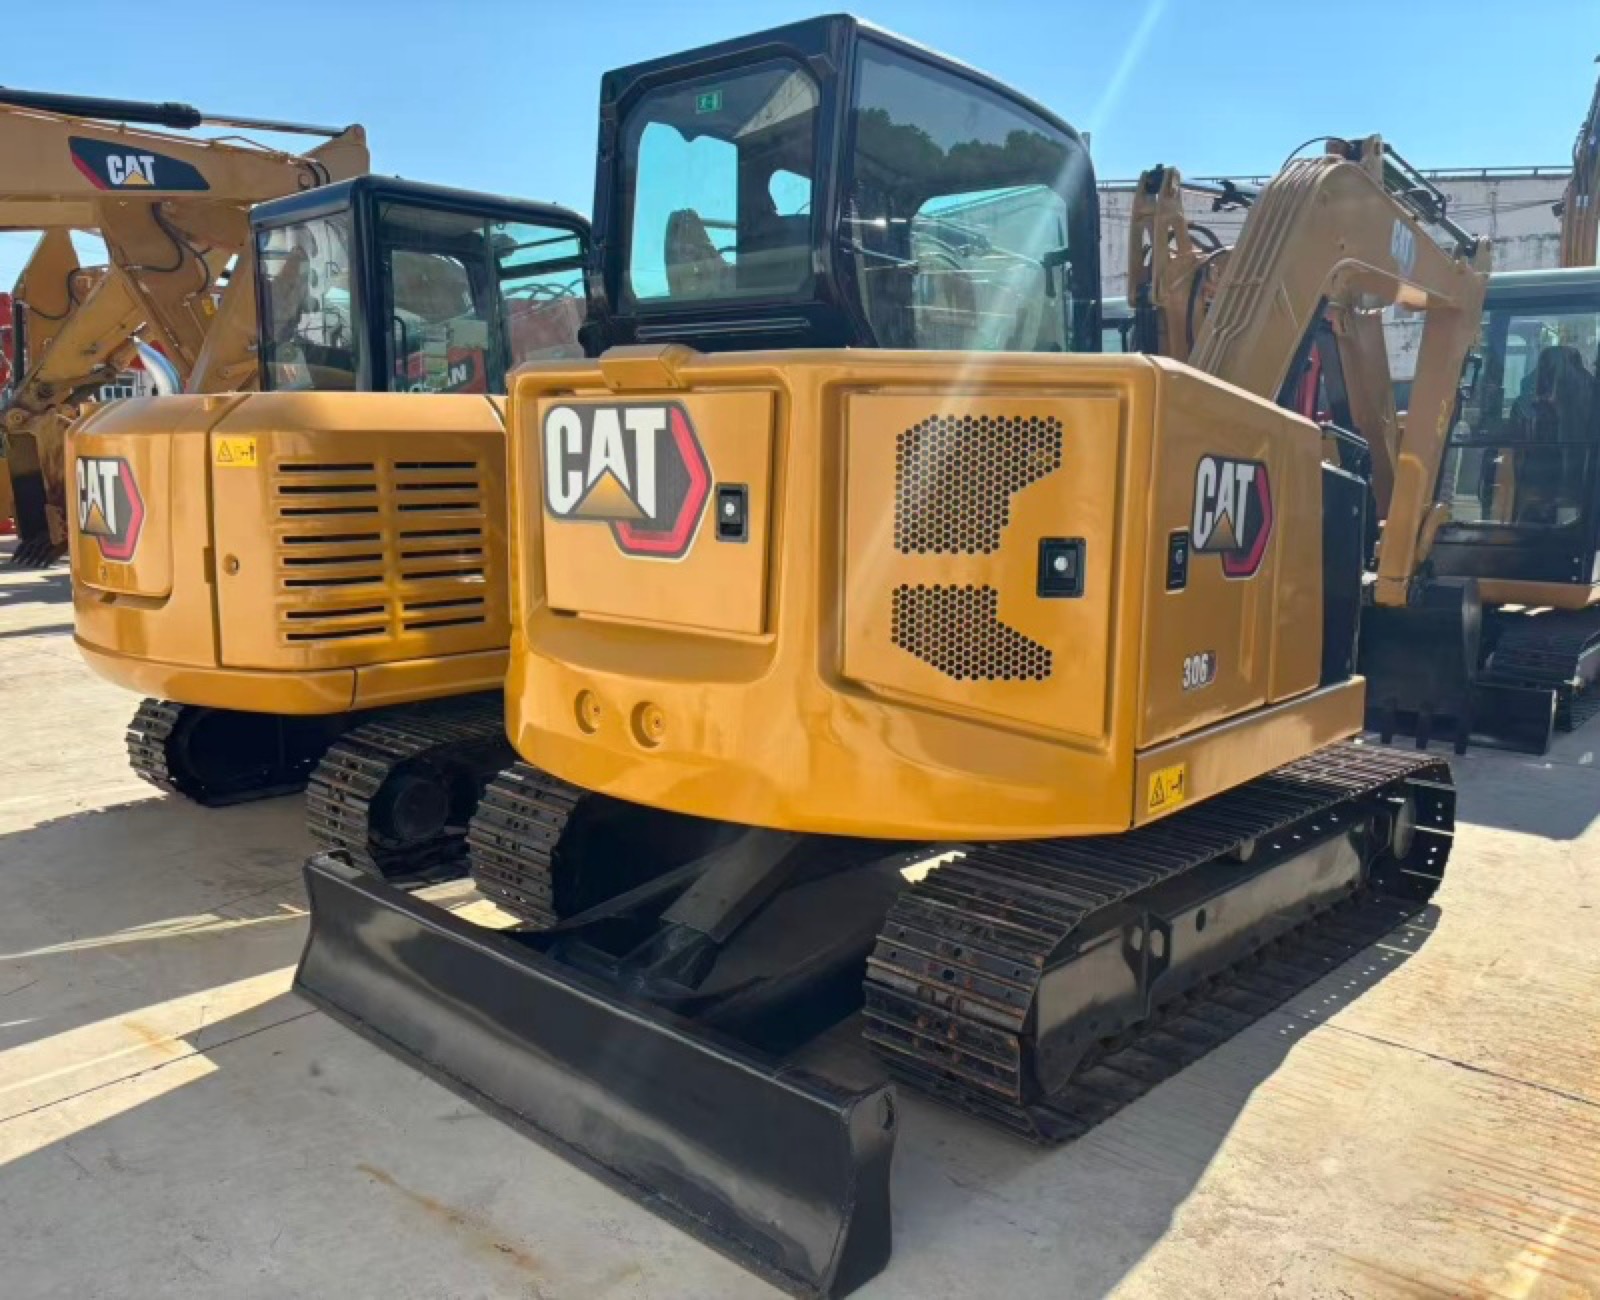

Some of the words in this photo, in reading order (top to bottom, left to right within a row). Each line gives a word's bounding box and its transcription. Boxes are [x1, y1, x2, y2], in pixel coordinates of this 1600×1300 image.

[106, 155, 155, 185] CAT
[76, 457, 119, 535] CAT
[546, 407, 667, 519] CAT
[1193, 457, 1255, 549] CAT
[1183, 653, 1209, 687] 306
